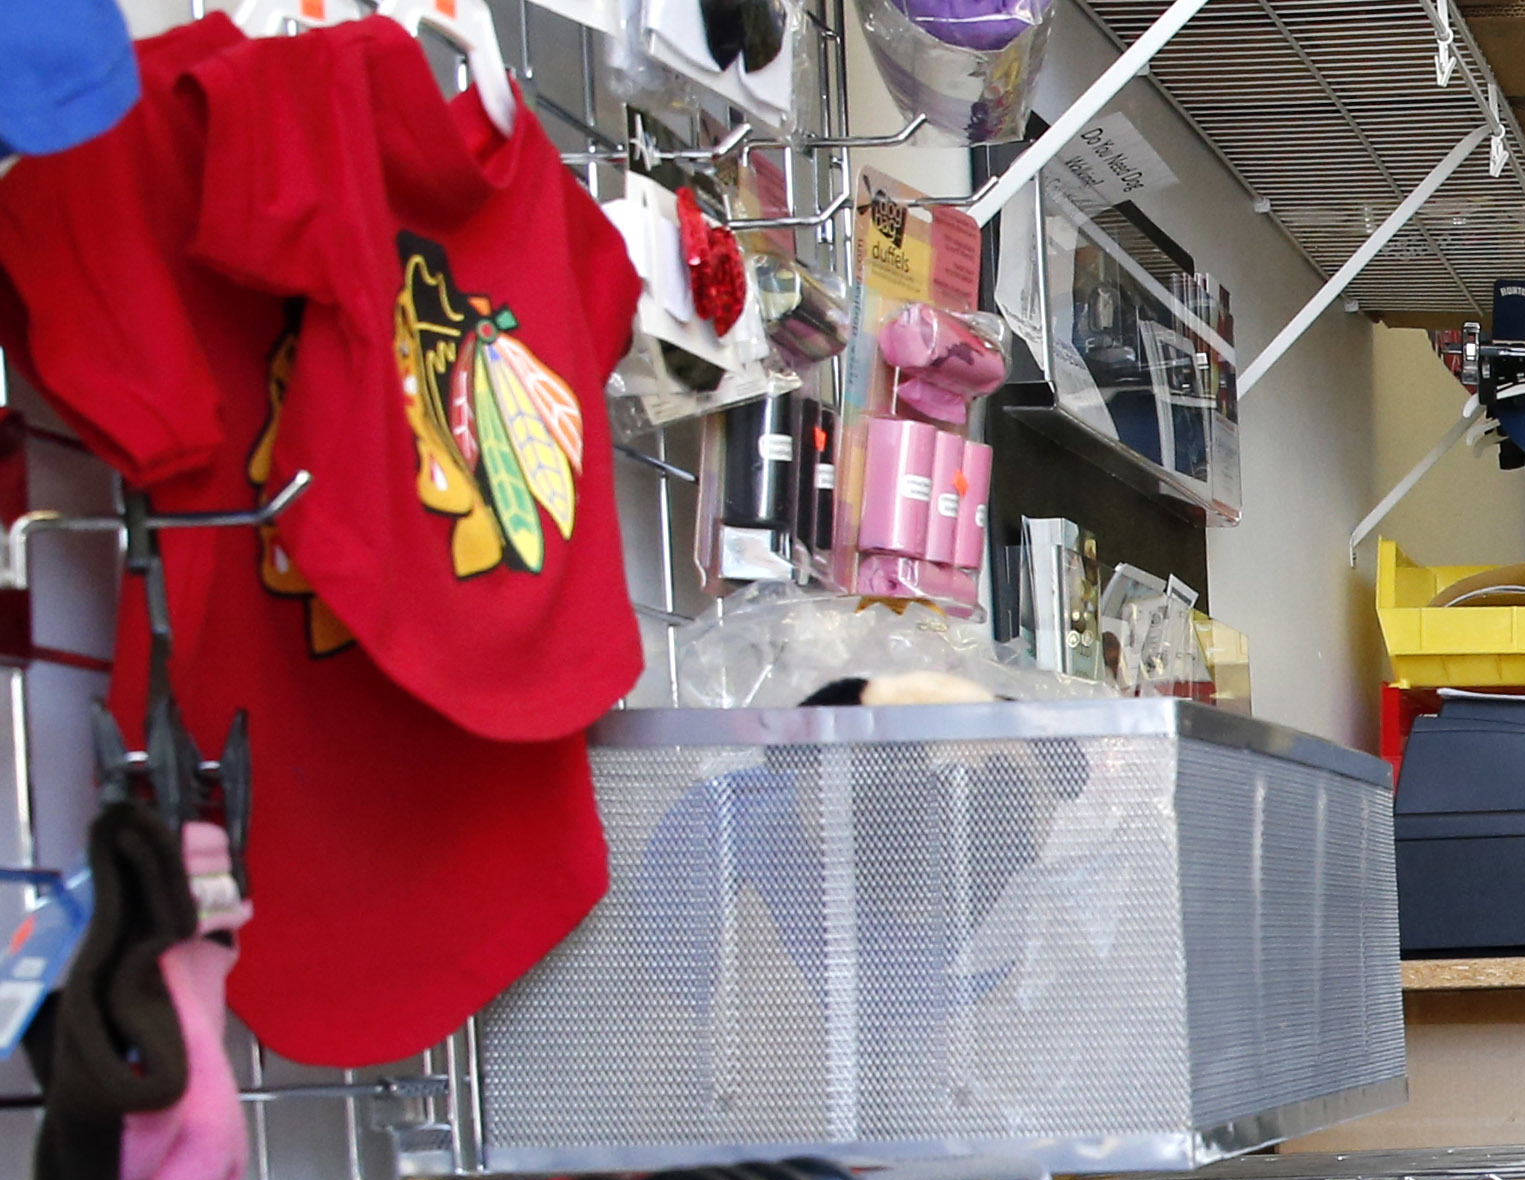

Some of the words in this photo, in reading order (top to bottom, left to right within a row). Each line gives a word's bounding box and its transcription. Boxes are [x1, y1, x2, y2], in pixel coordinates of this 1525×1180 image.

[1081, 127, 1104, 146] Do
[1093, 139, 1115, 158] You
[1104, 153, 1137, 176] Need
[1121, 171, 1145, 193] Dog
[871, 243, 910, 273] duffels
